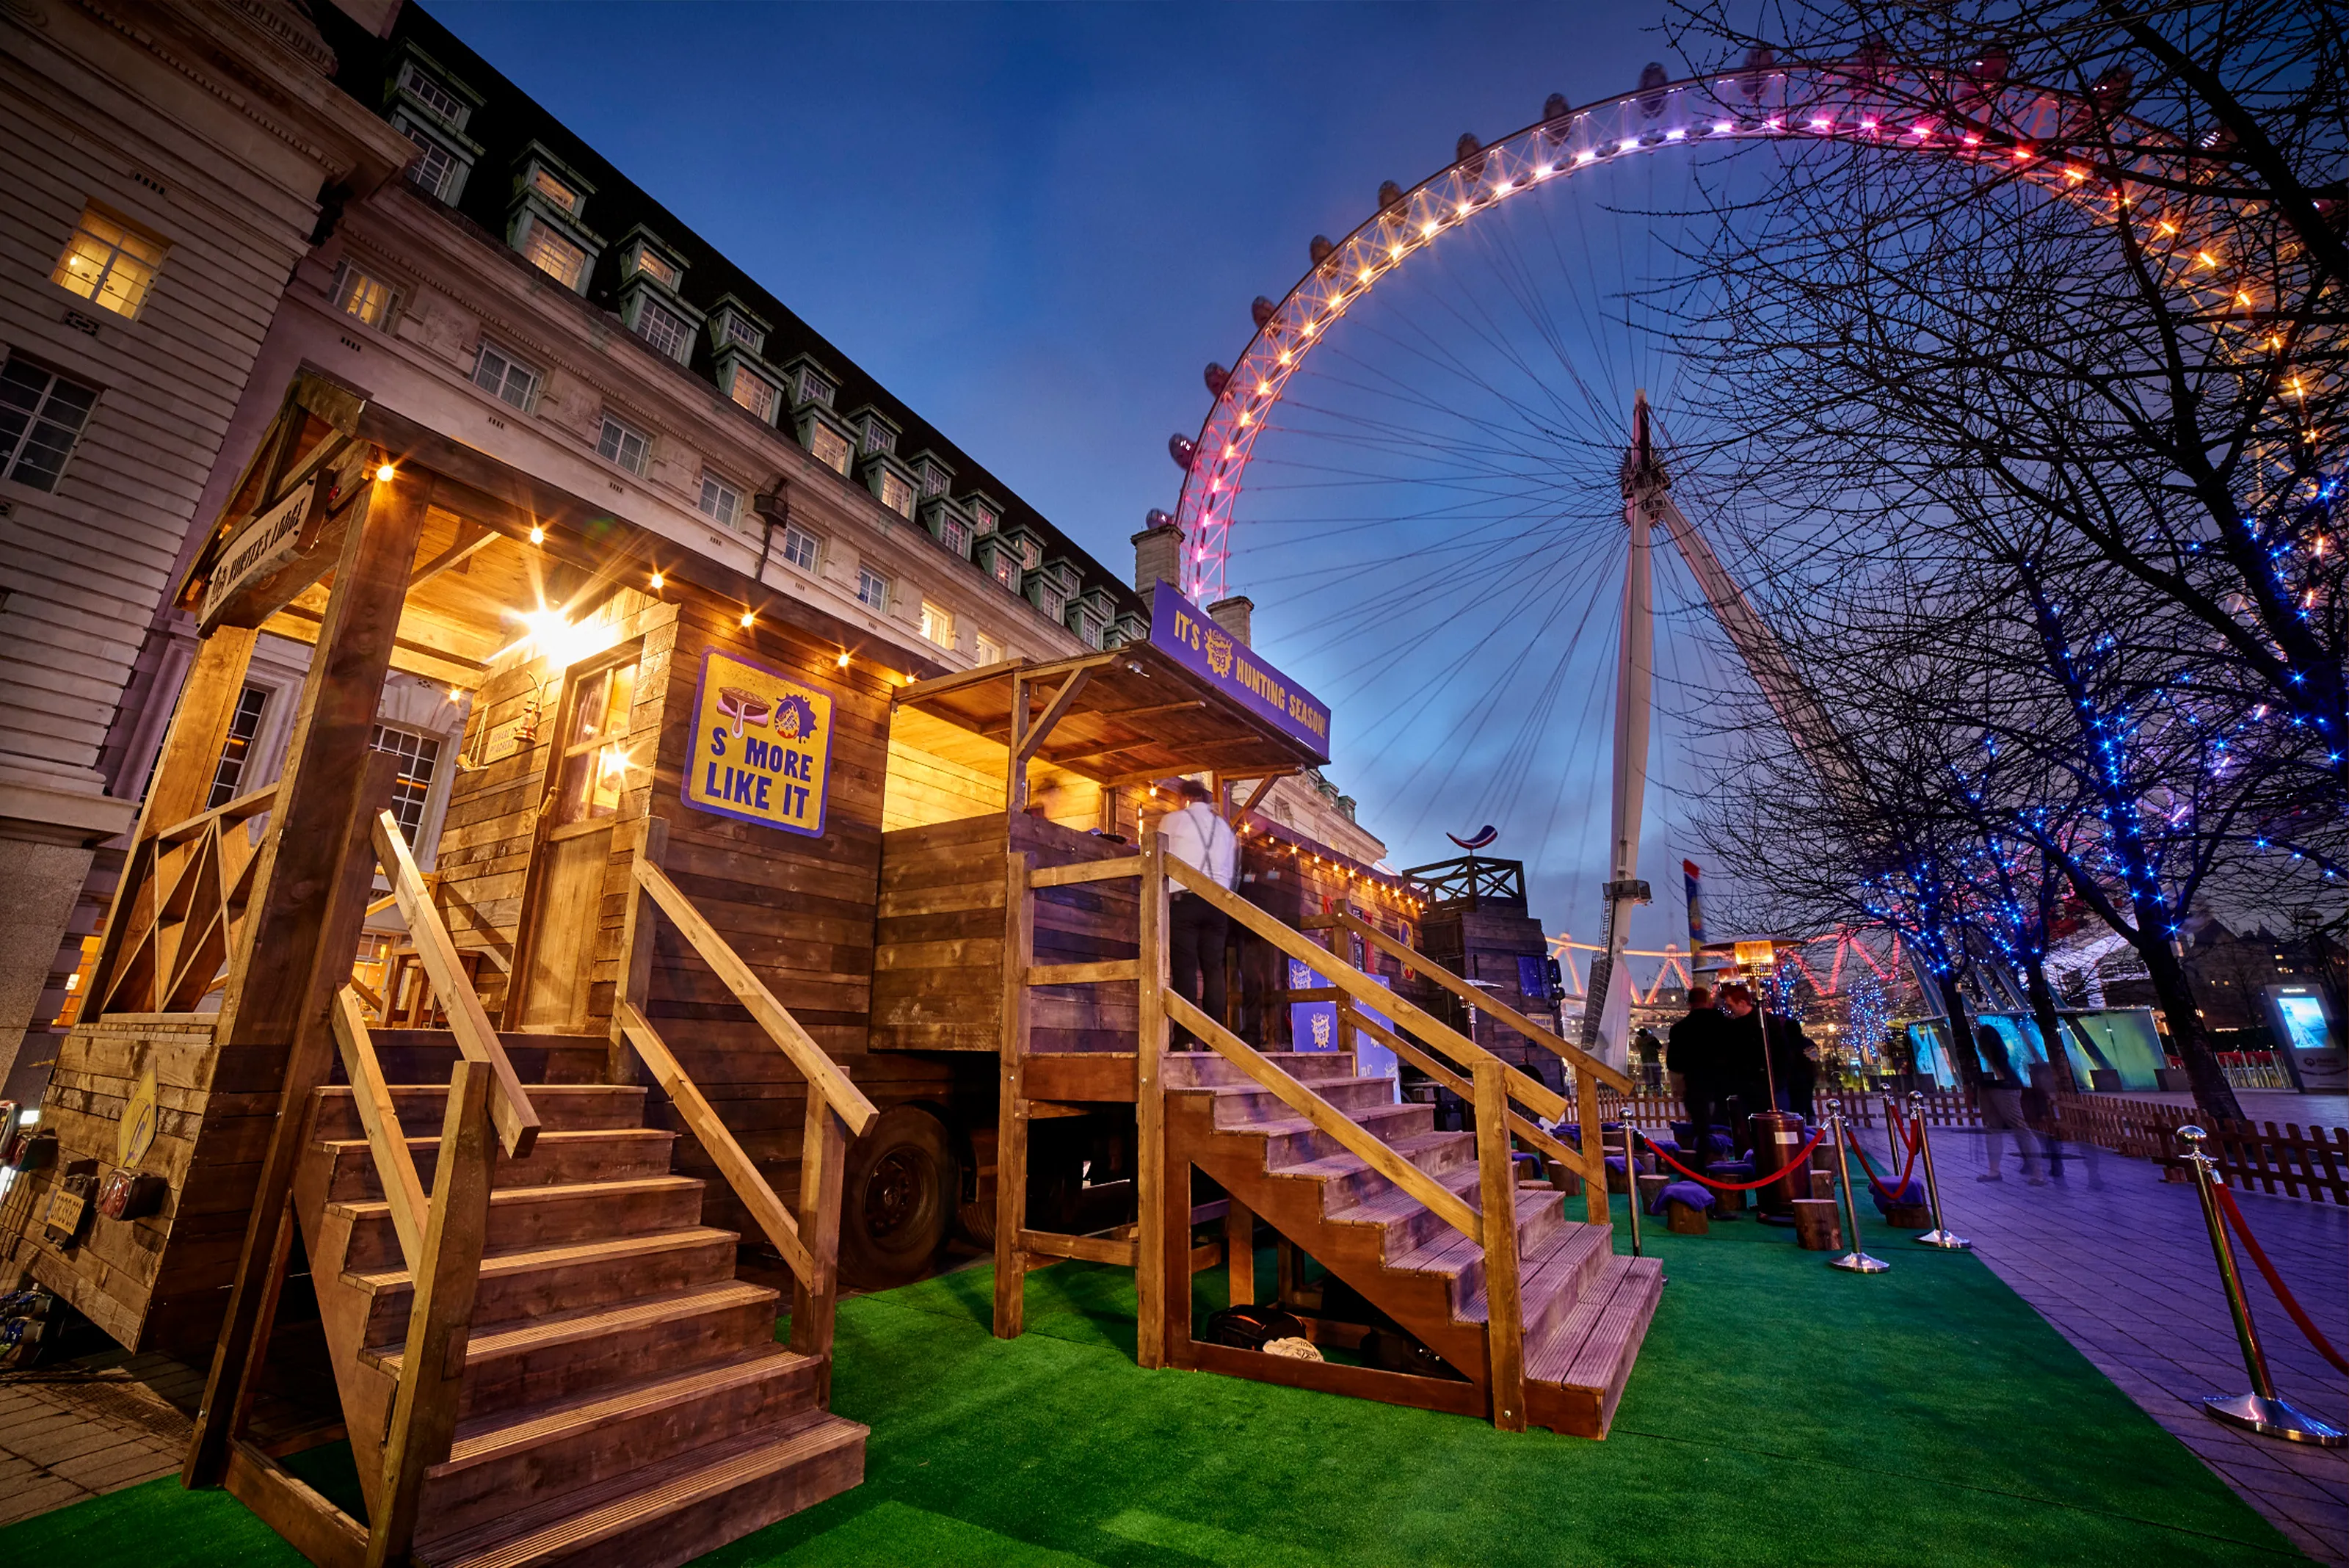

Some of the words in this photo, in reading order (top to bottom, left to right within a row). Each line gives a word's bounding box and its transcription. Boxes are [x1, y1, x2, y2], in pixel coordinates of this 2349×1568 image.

[269, 497, 306, 549] LODGE
[1174, 610, 1200, 650] IT'S
[1236, 656, 1285, 711] HUNTING
[1289, 694, 1326, 739] SEASON!
[744, 736, 813, 783] MORE
[705, 761, 772, 810] LIKE
[783, 783, 810, 819] IT
